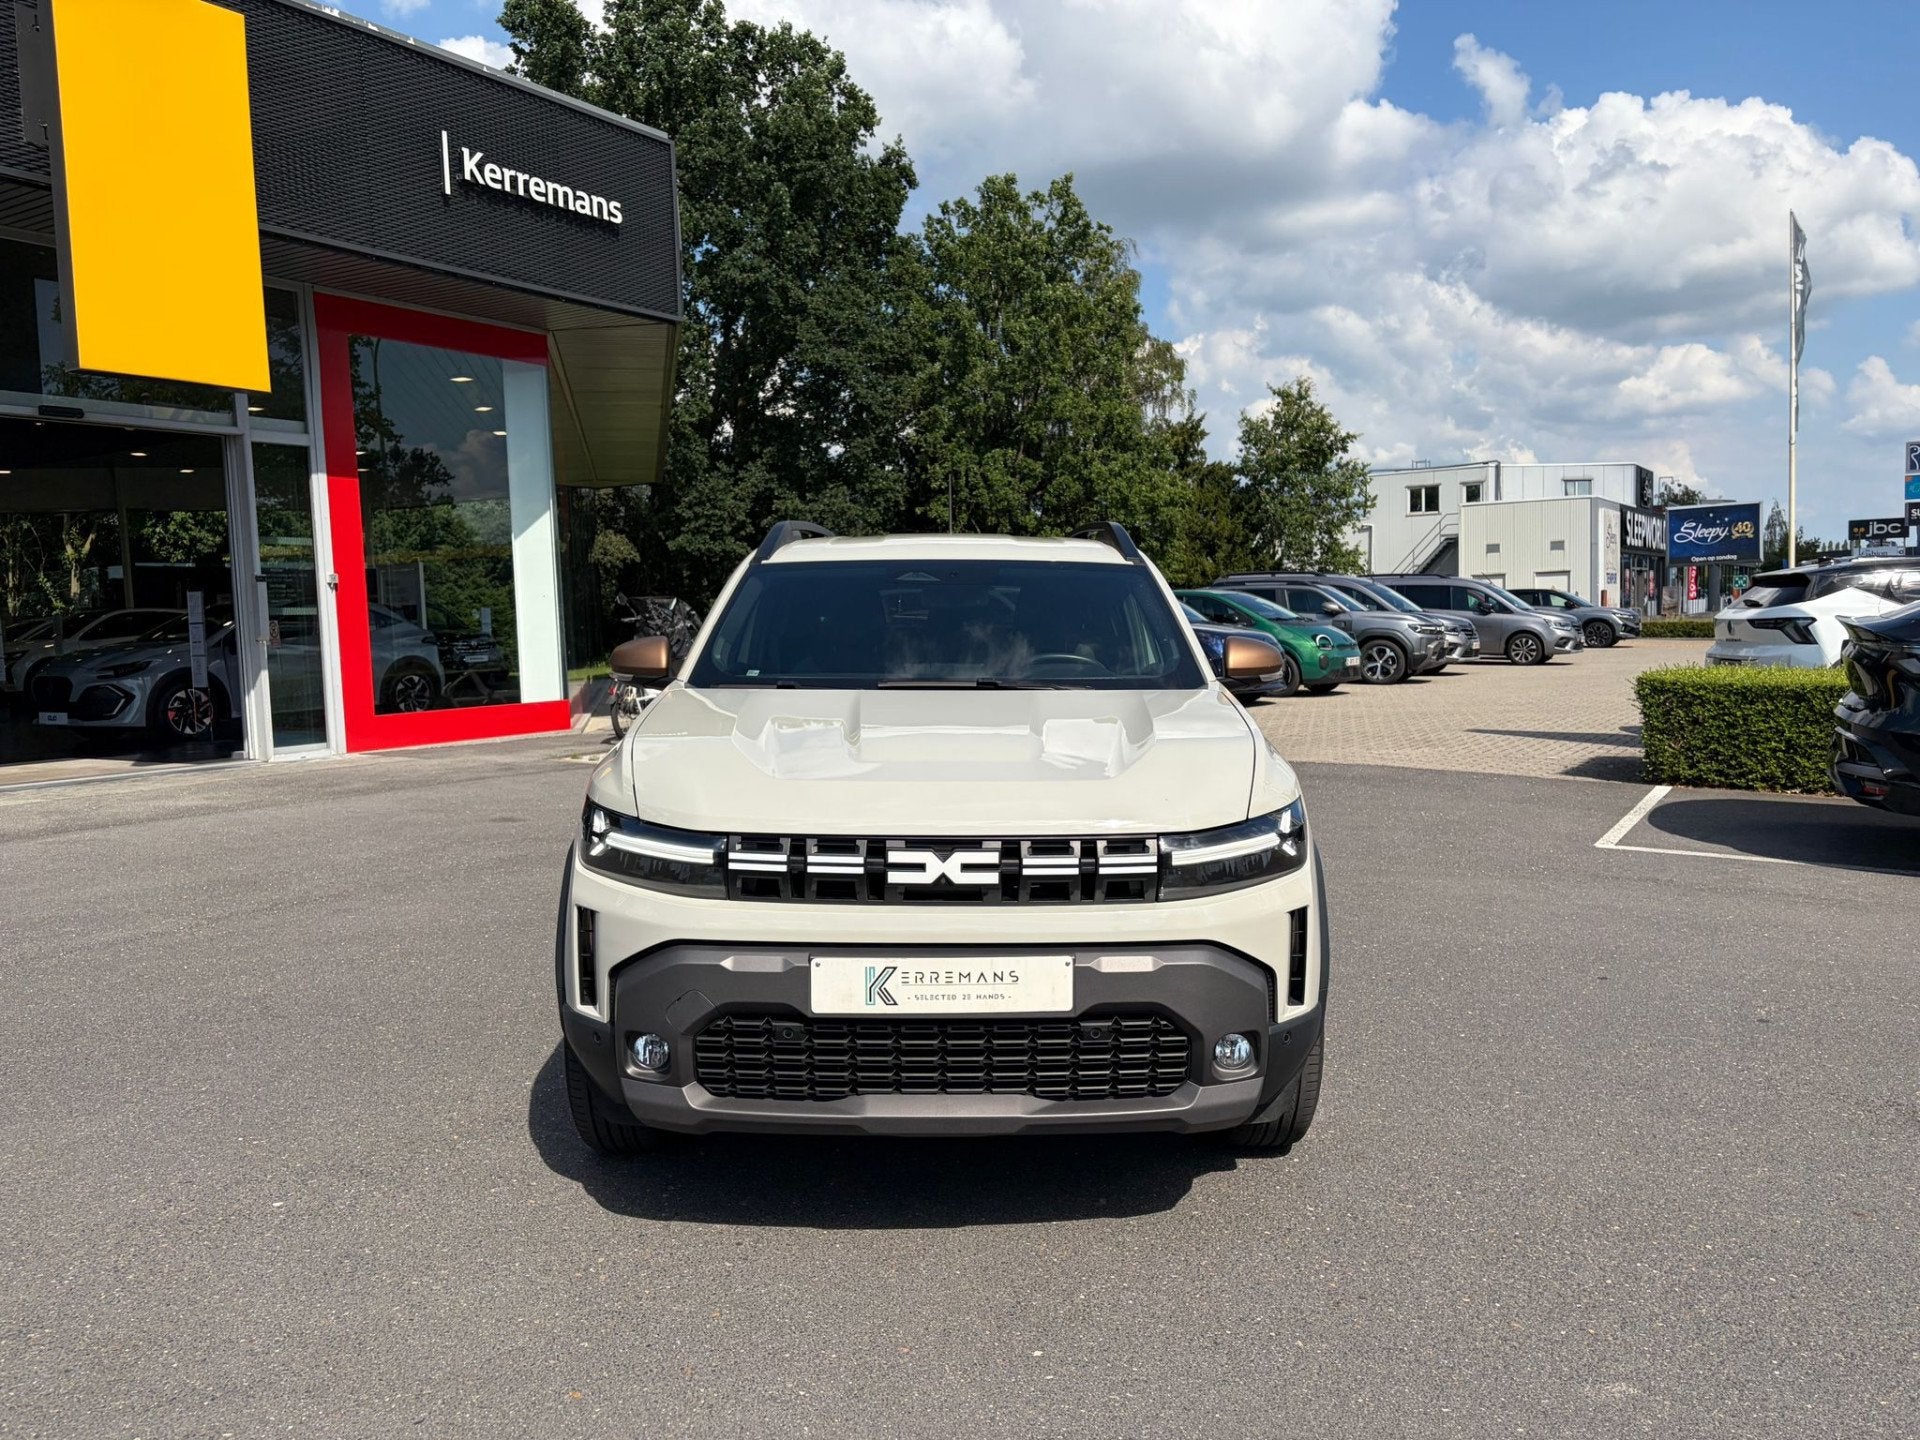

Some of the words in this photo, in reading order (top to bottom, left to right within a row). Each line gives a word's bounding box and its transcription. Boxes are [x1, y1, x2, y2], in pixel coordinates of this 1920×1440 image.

[461, 146, 623, 224] Kerremans
[1674, 518, 1729, 545] Sleepy
[1866, 521, 1902, 537] jbc
